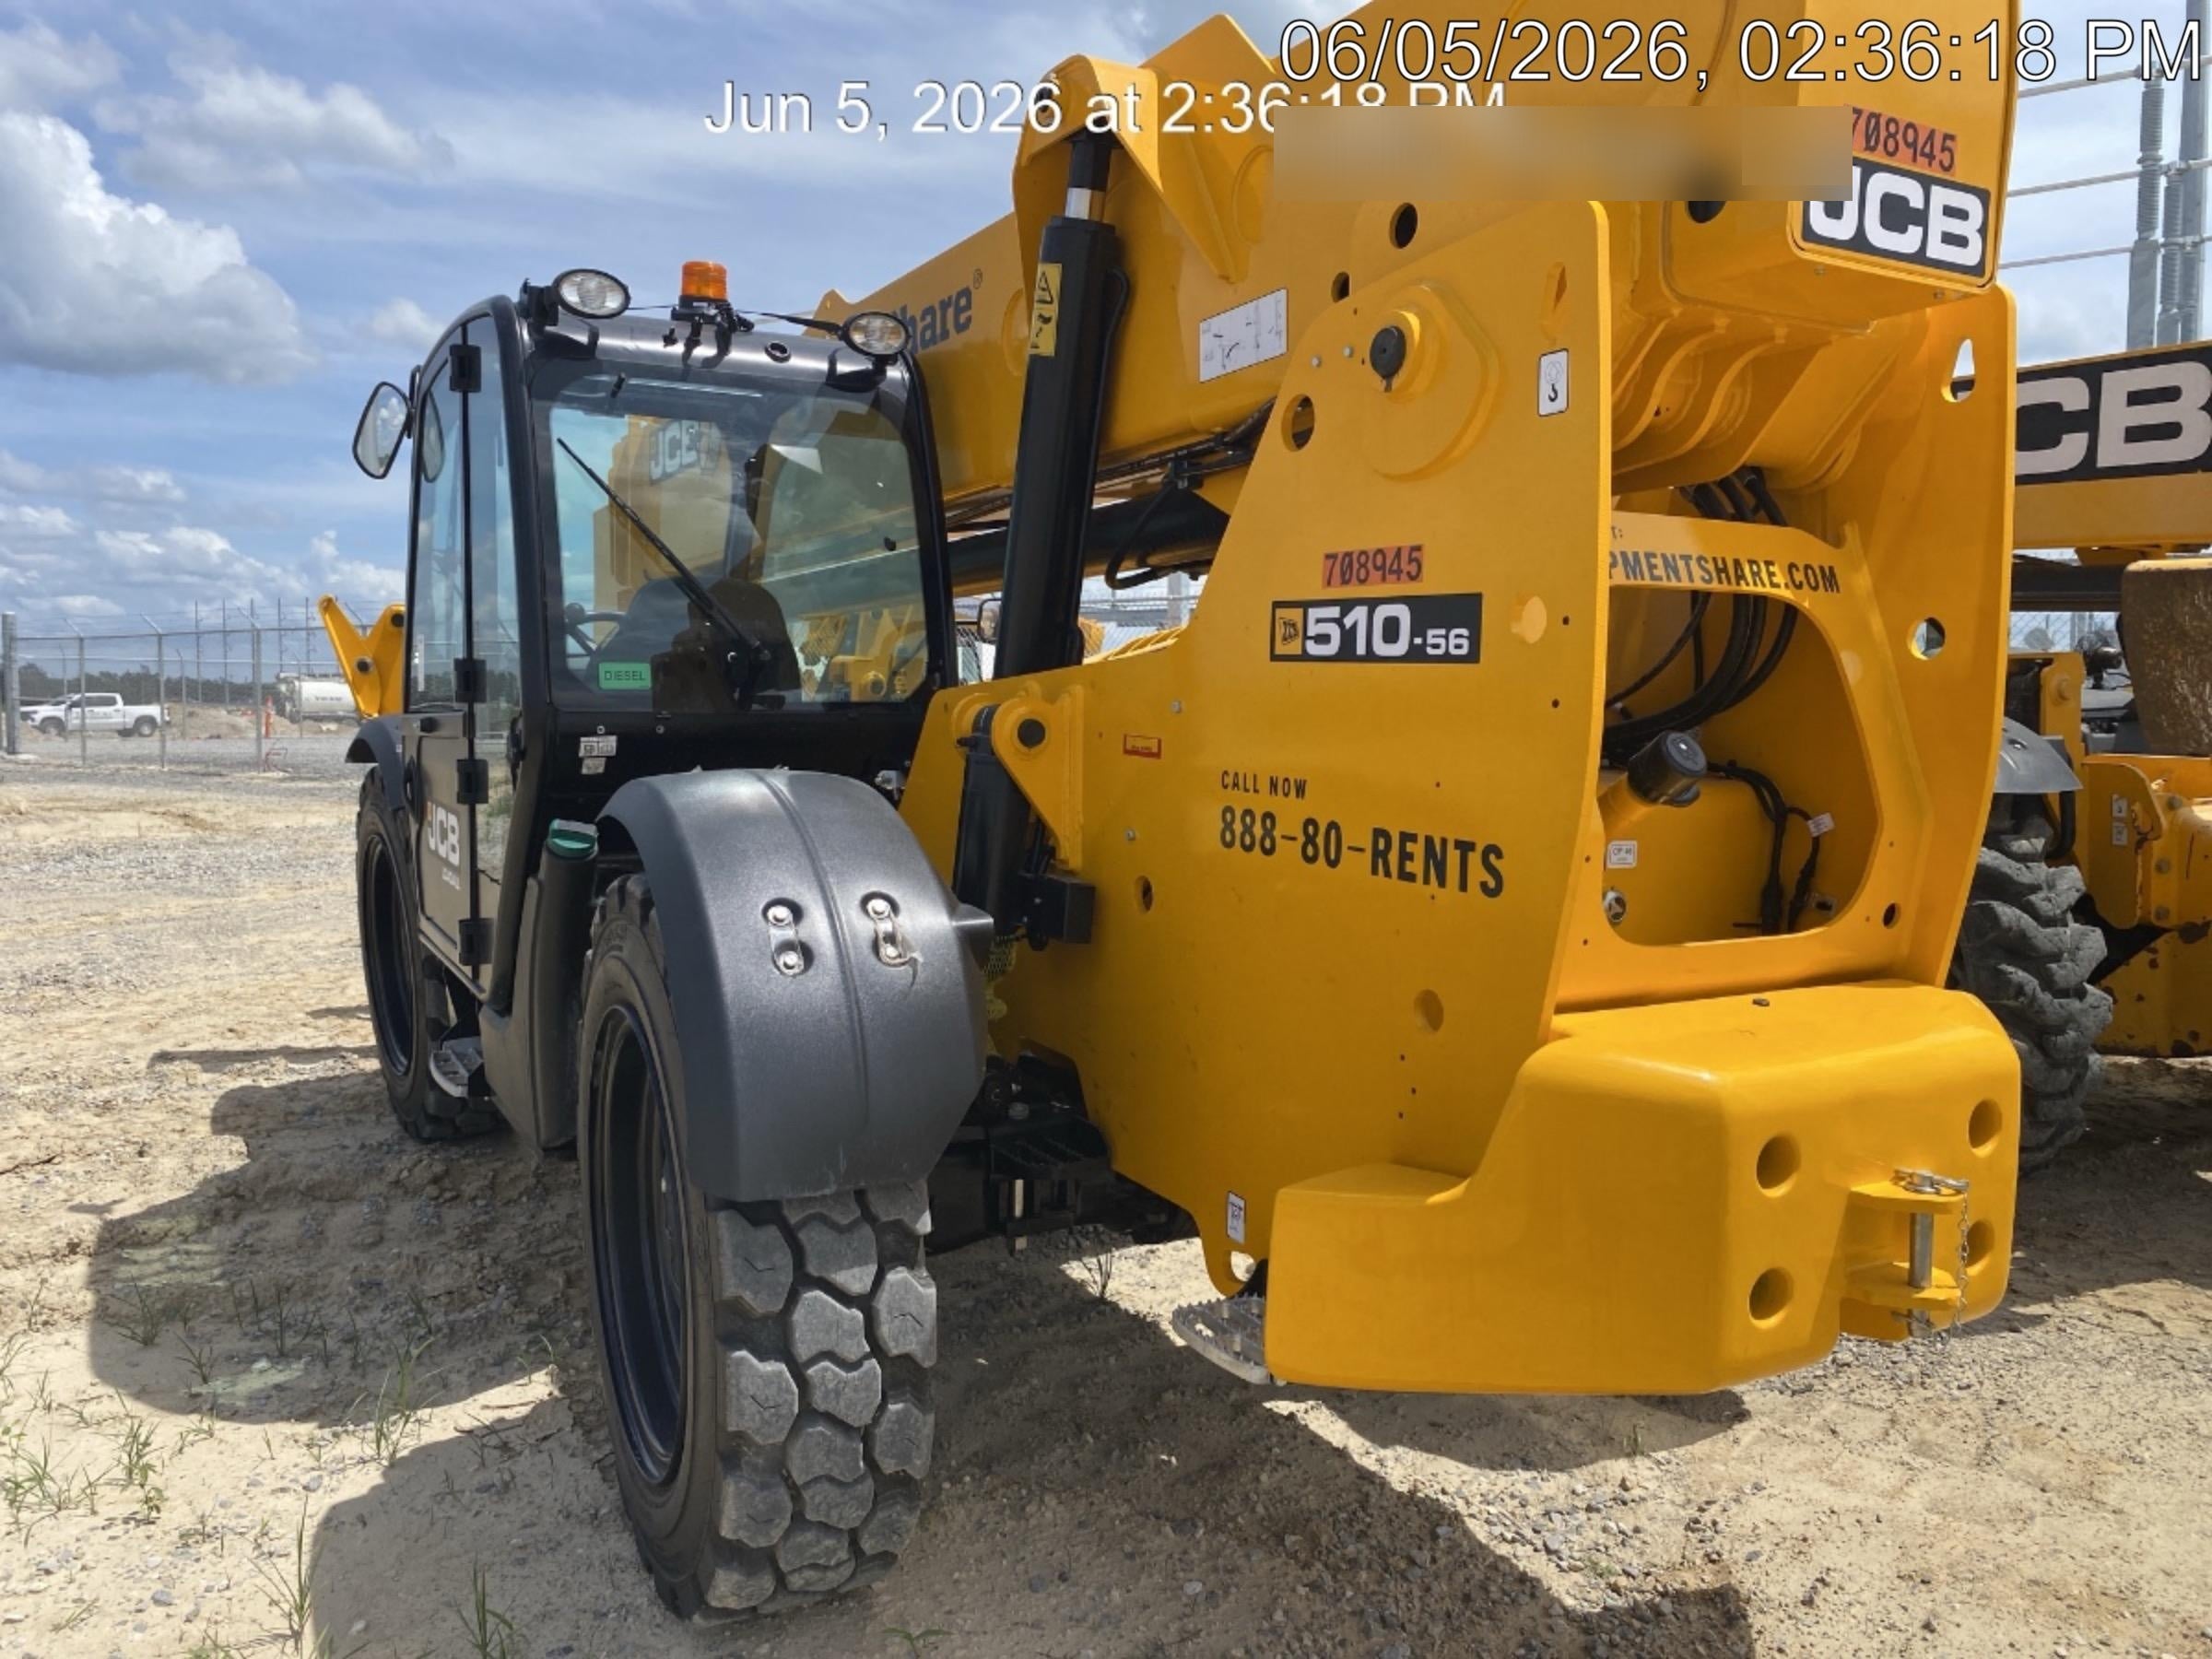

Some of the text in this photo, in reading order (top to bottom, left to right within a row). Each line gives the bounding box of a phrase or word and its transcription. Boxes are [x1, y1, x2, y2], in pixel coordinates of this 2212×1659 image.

[1809, 165, 1984, 266] JCB
[2016, 360, 2212, 477] CB
[1324, 545, 1423, 587] 708945
[1609, 550, 1841, 594] PMENTSHARE.COM
[1305, 604, 1471, 657] 510-56
[604, 670, 646, 681] DIESEL
[1221, 771, 1308, 800] CALL NOW
[427, 803, 460, 867] JCB
[1219, 805, 1505, 899] 888-80-RENTS
